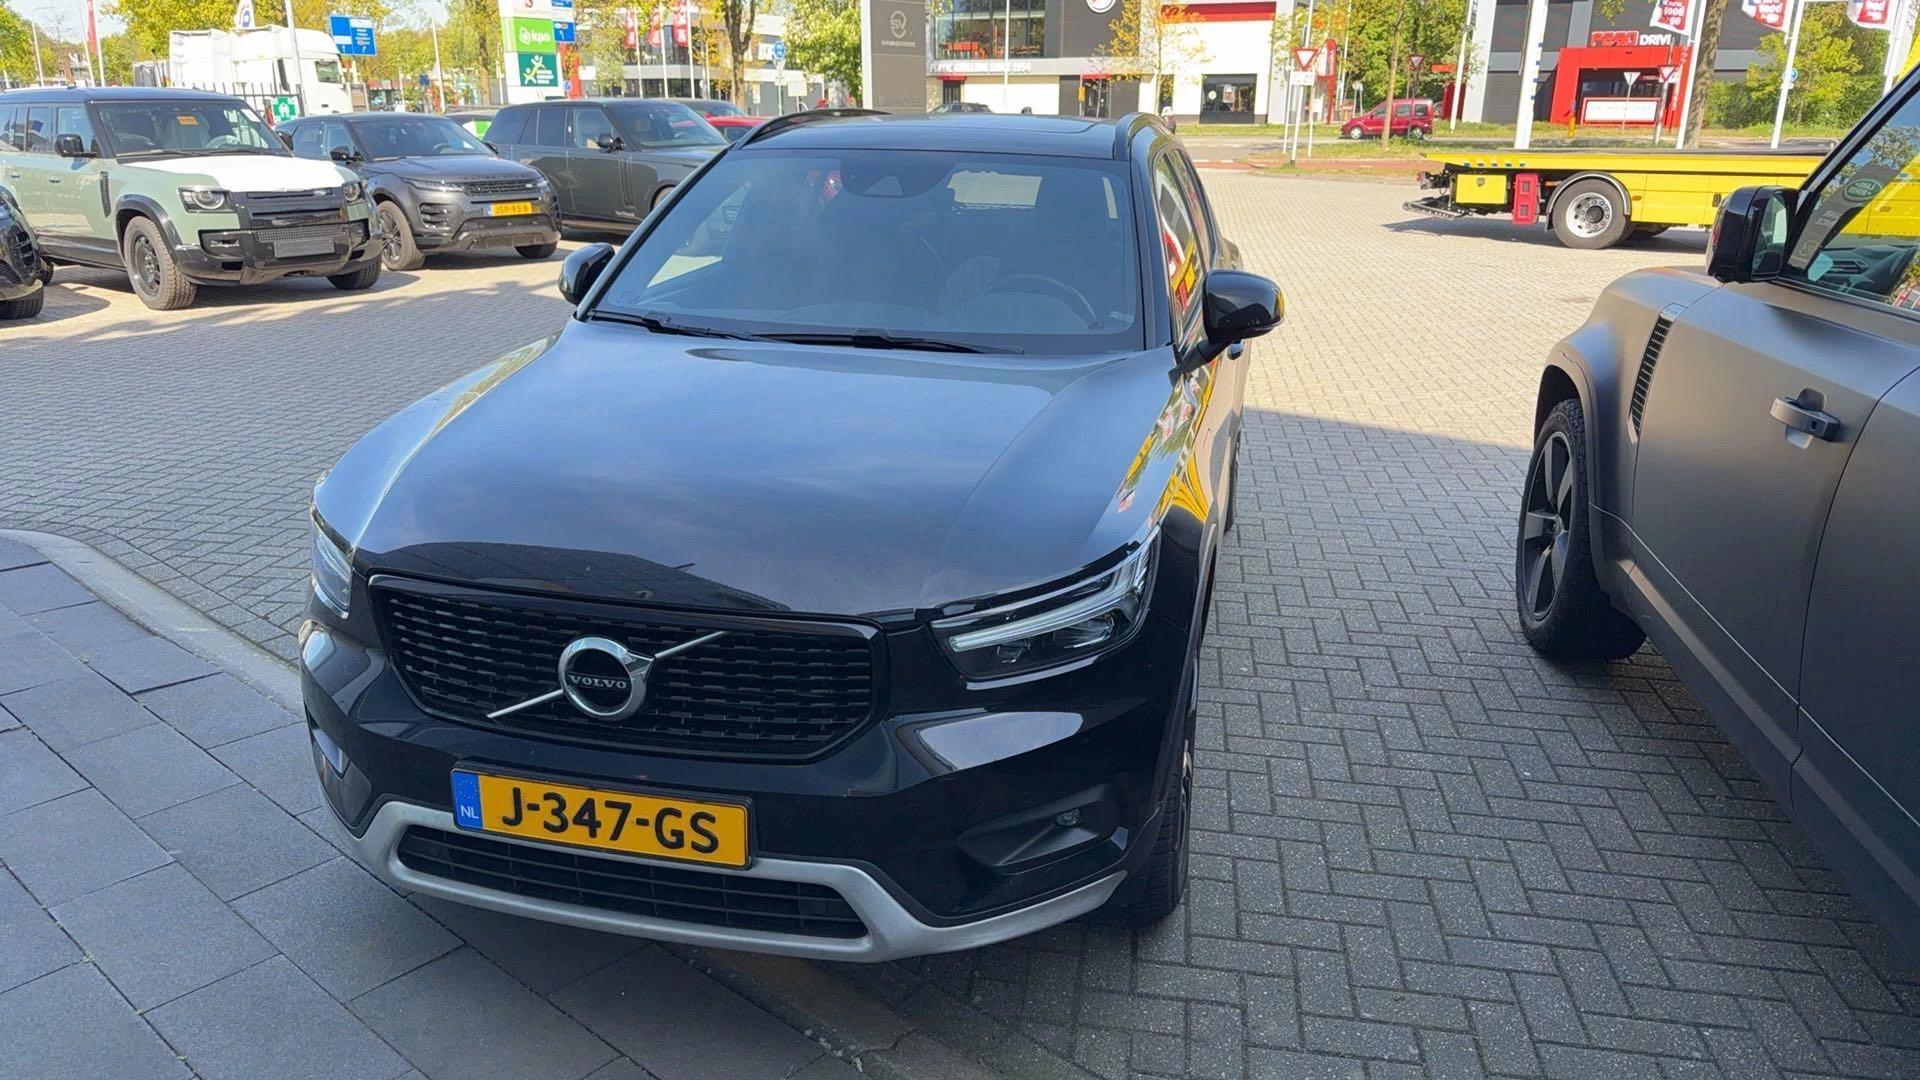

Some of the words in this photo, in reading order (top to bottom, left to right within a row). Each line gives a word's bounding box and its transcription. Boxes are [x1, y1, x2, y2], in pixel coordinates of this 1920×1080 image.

[567, 675, 627, 690] VOLVO
[461, 805, 480, 820] NL
[502, 786, 719, 854] J-347-GS
